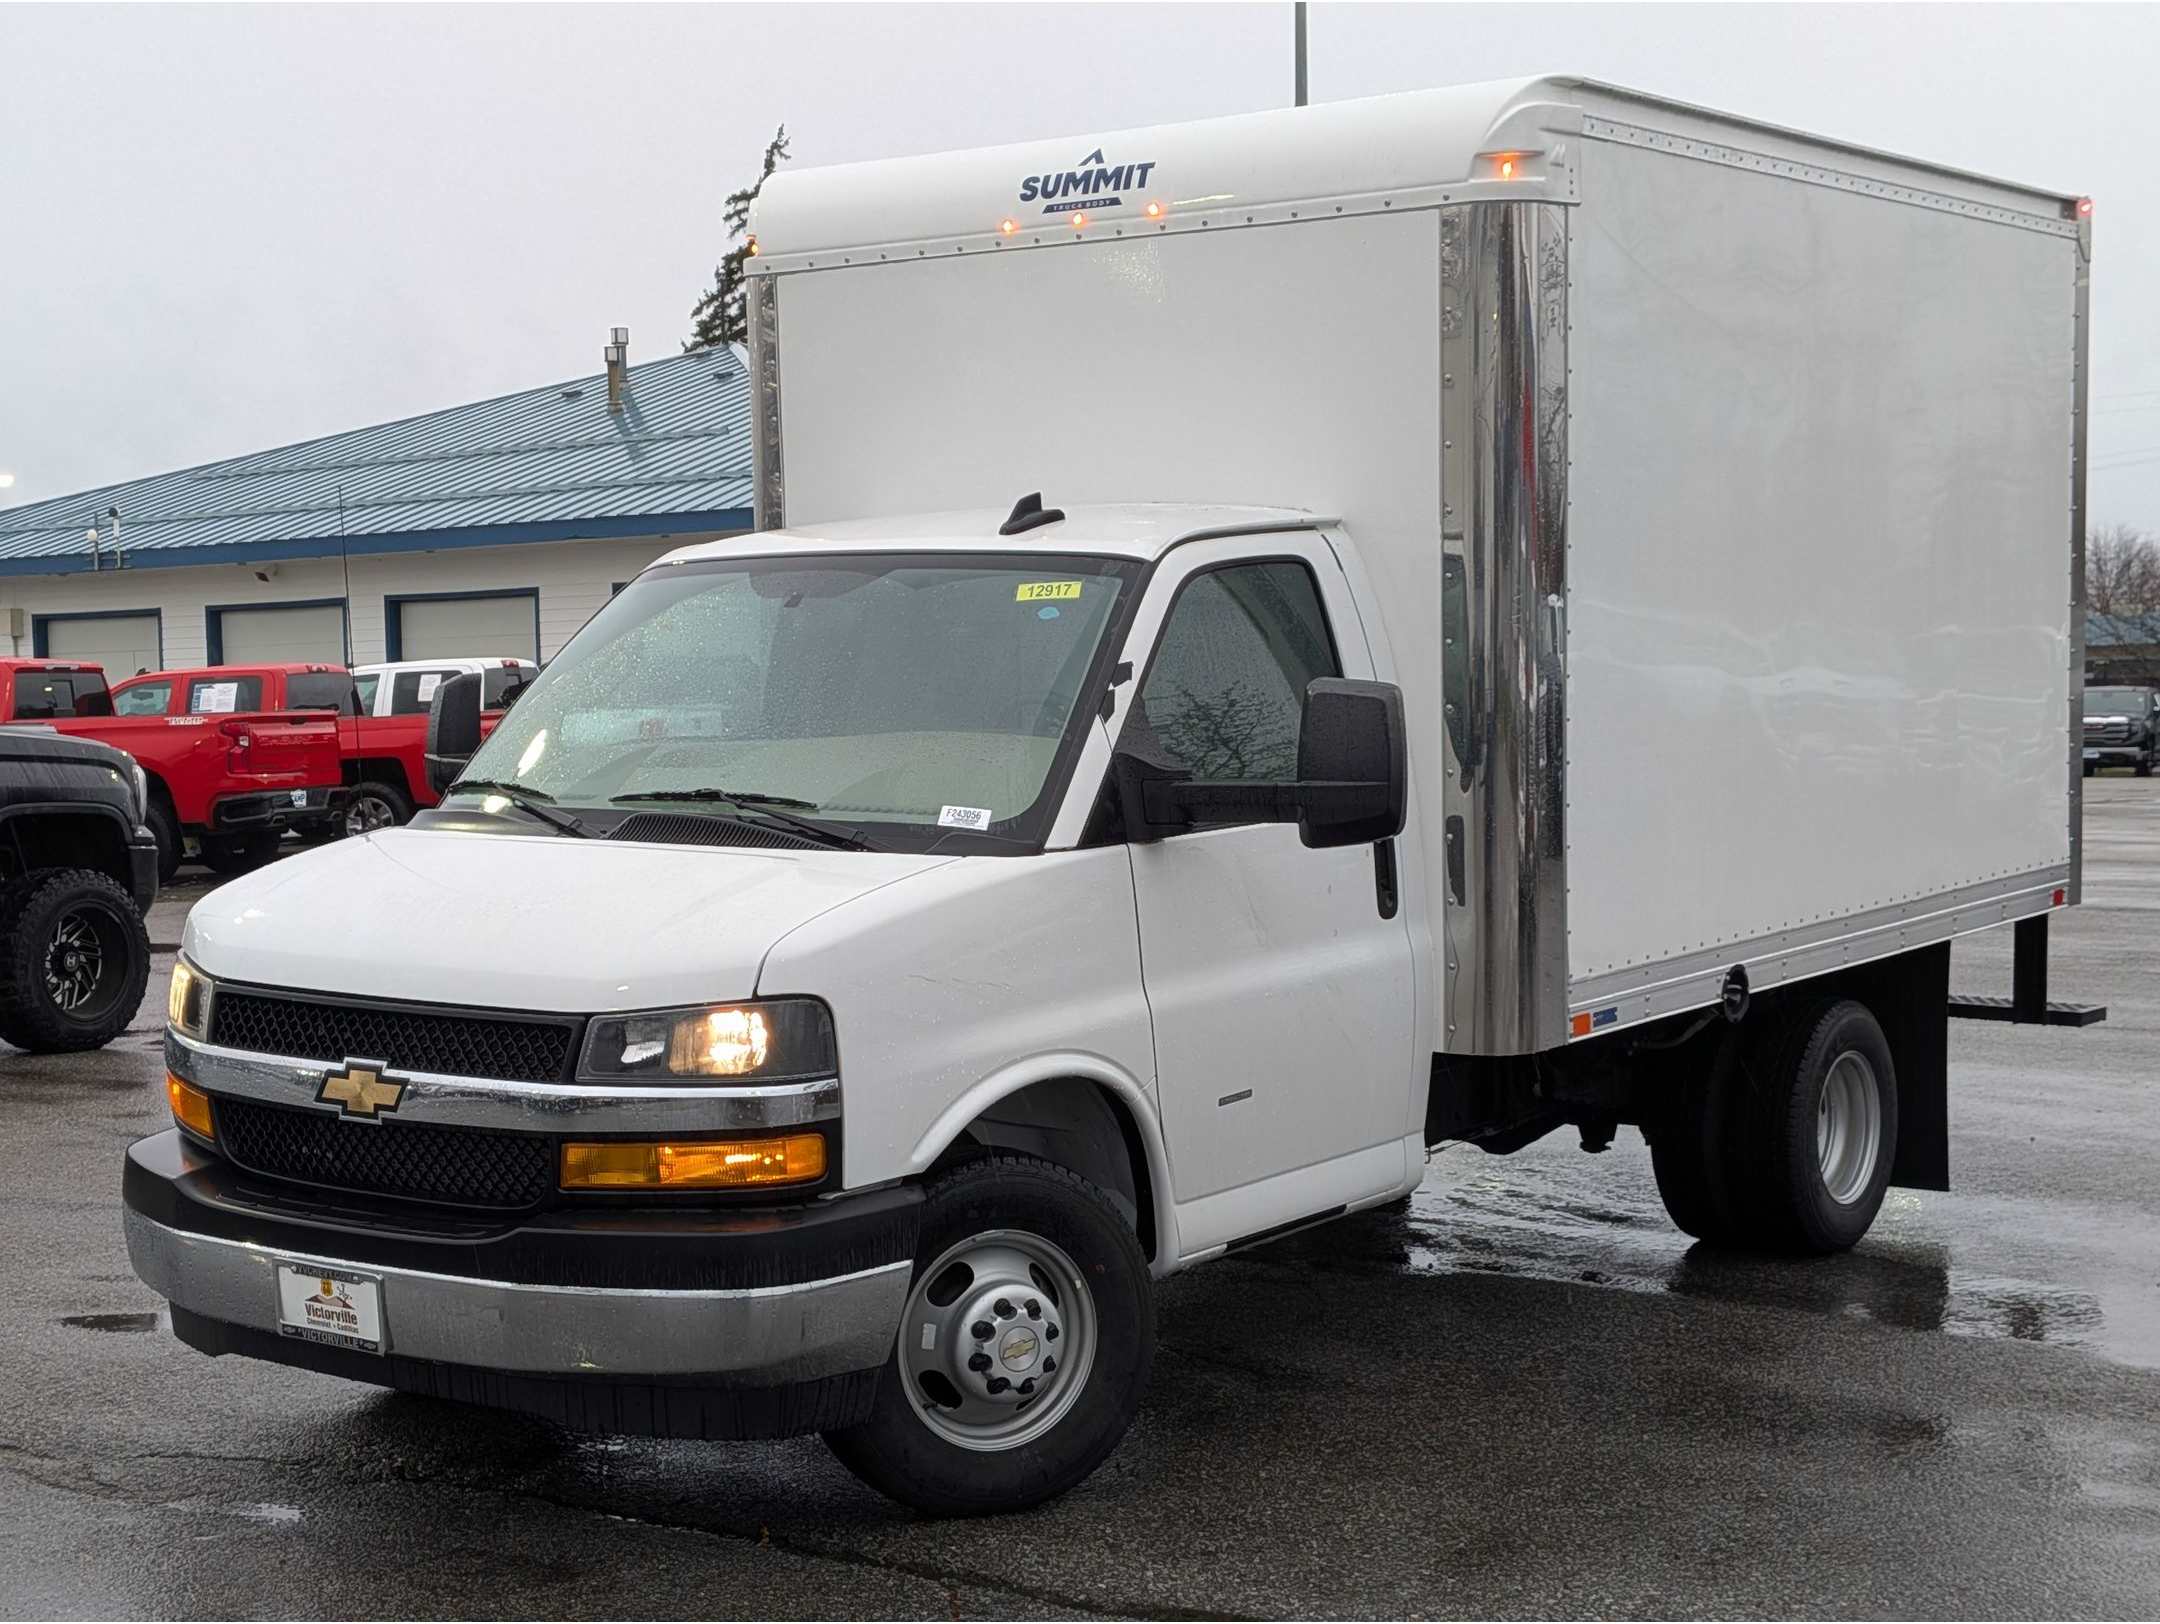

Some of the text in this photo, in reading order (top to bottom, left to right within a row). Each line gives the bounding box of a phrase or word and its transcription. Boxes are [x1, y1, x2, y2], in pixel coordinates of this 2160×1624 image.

[1019, 162, 1156, 201] SUMMIT
[1053, 200, 1112, 211] TRUCK BODY
[1027, 584, 1072, 598] 12917
[305, 1303, 358, 1325] Victorville
[302, 1328, 358, 1347] VICTORVILLE
